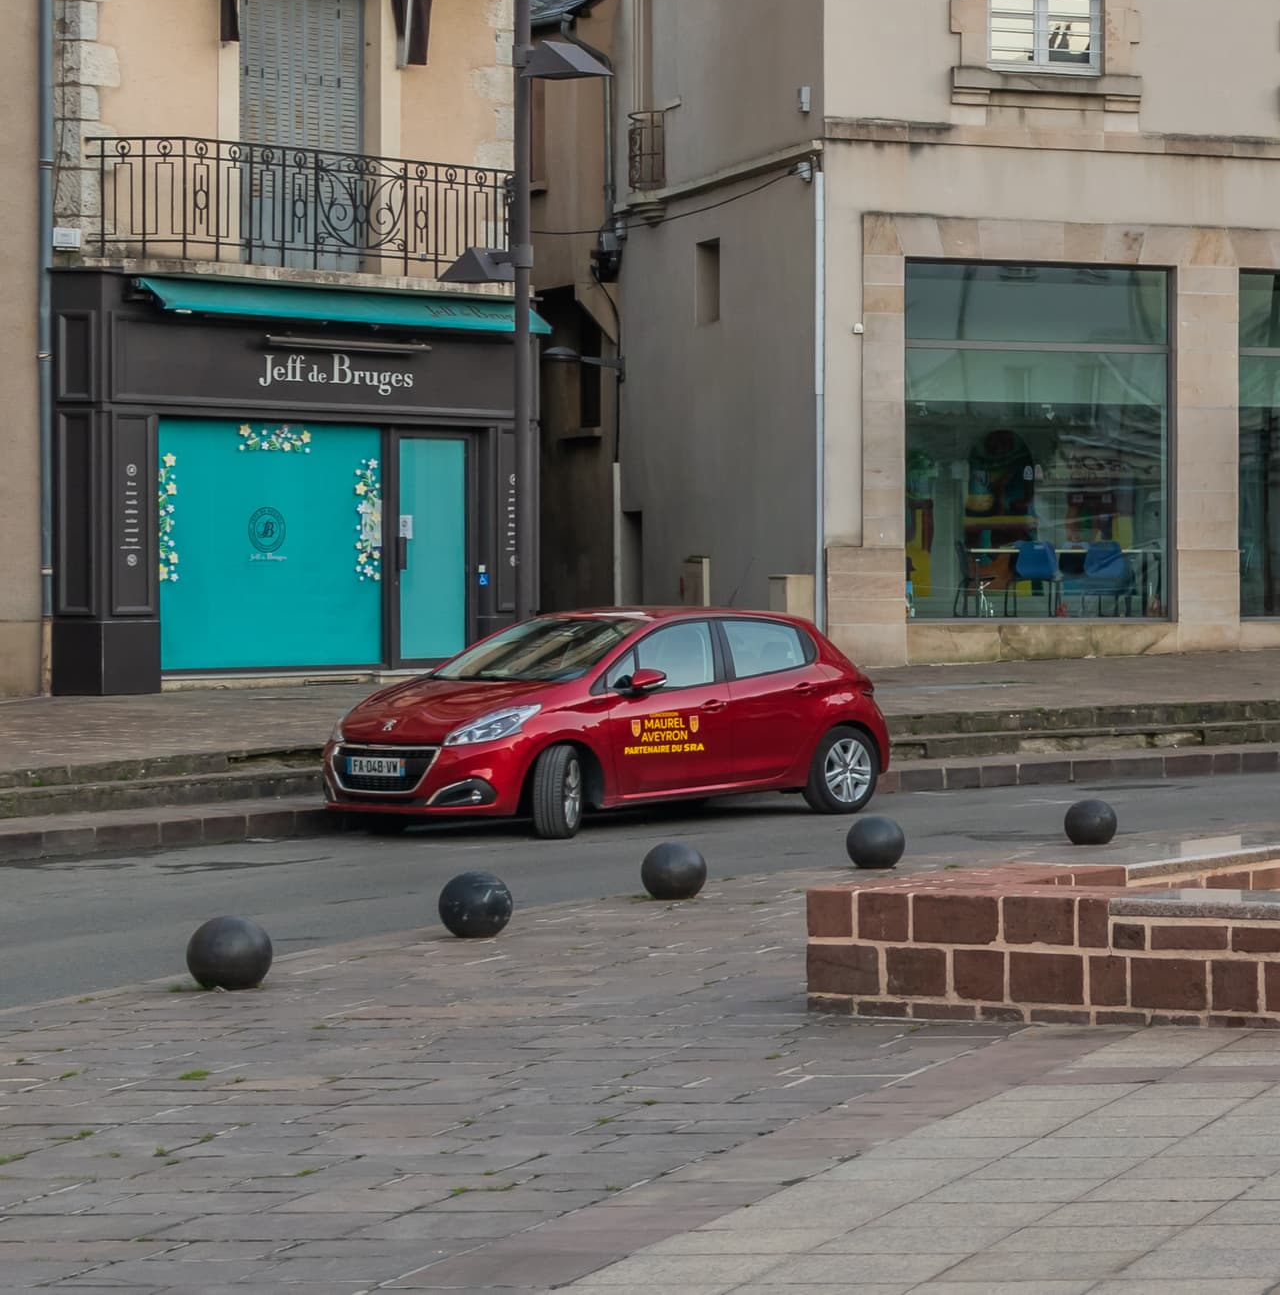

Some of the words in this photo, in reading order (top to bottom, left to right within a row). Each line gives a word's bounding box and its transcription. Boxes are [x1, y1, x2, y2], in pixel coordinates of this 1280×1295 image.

[258, 354, 306, 387] Jeff
[308, 365, 327, 383] de
[329, 353, 414, 396] Bruges
[644, 717, 685, 729] MAUREL
[641, 730, 688, 742] AVEYRON
[624, 744, 670, 755] PARTENAIRE
[671, 744, 682, 753] DU
[684, 743, 705, 752] SRA
